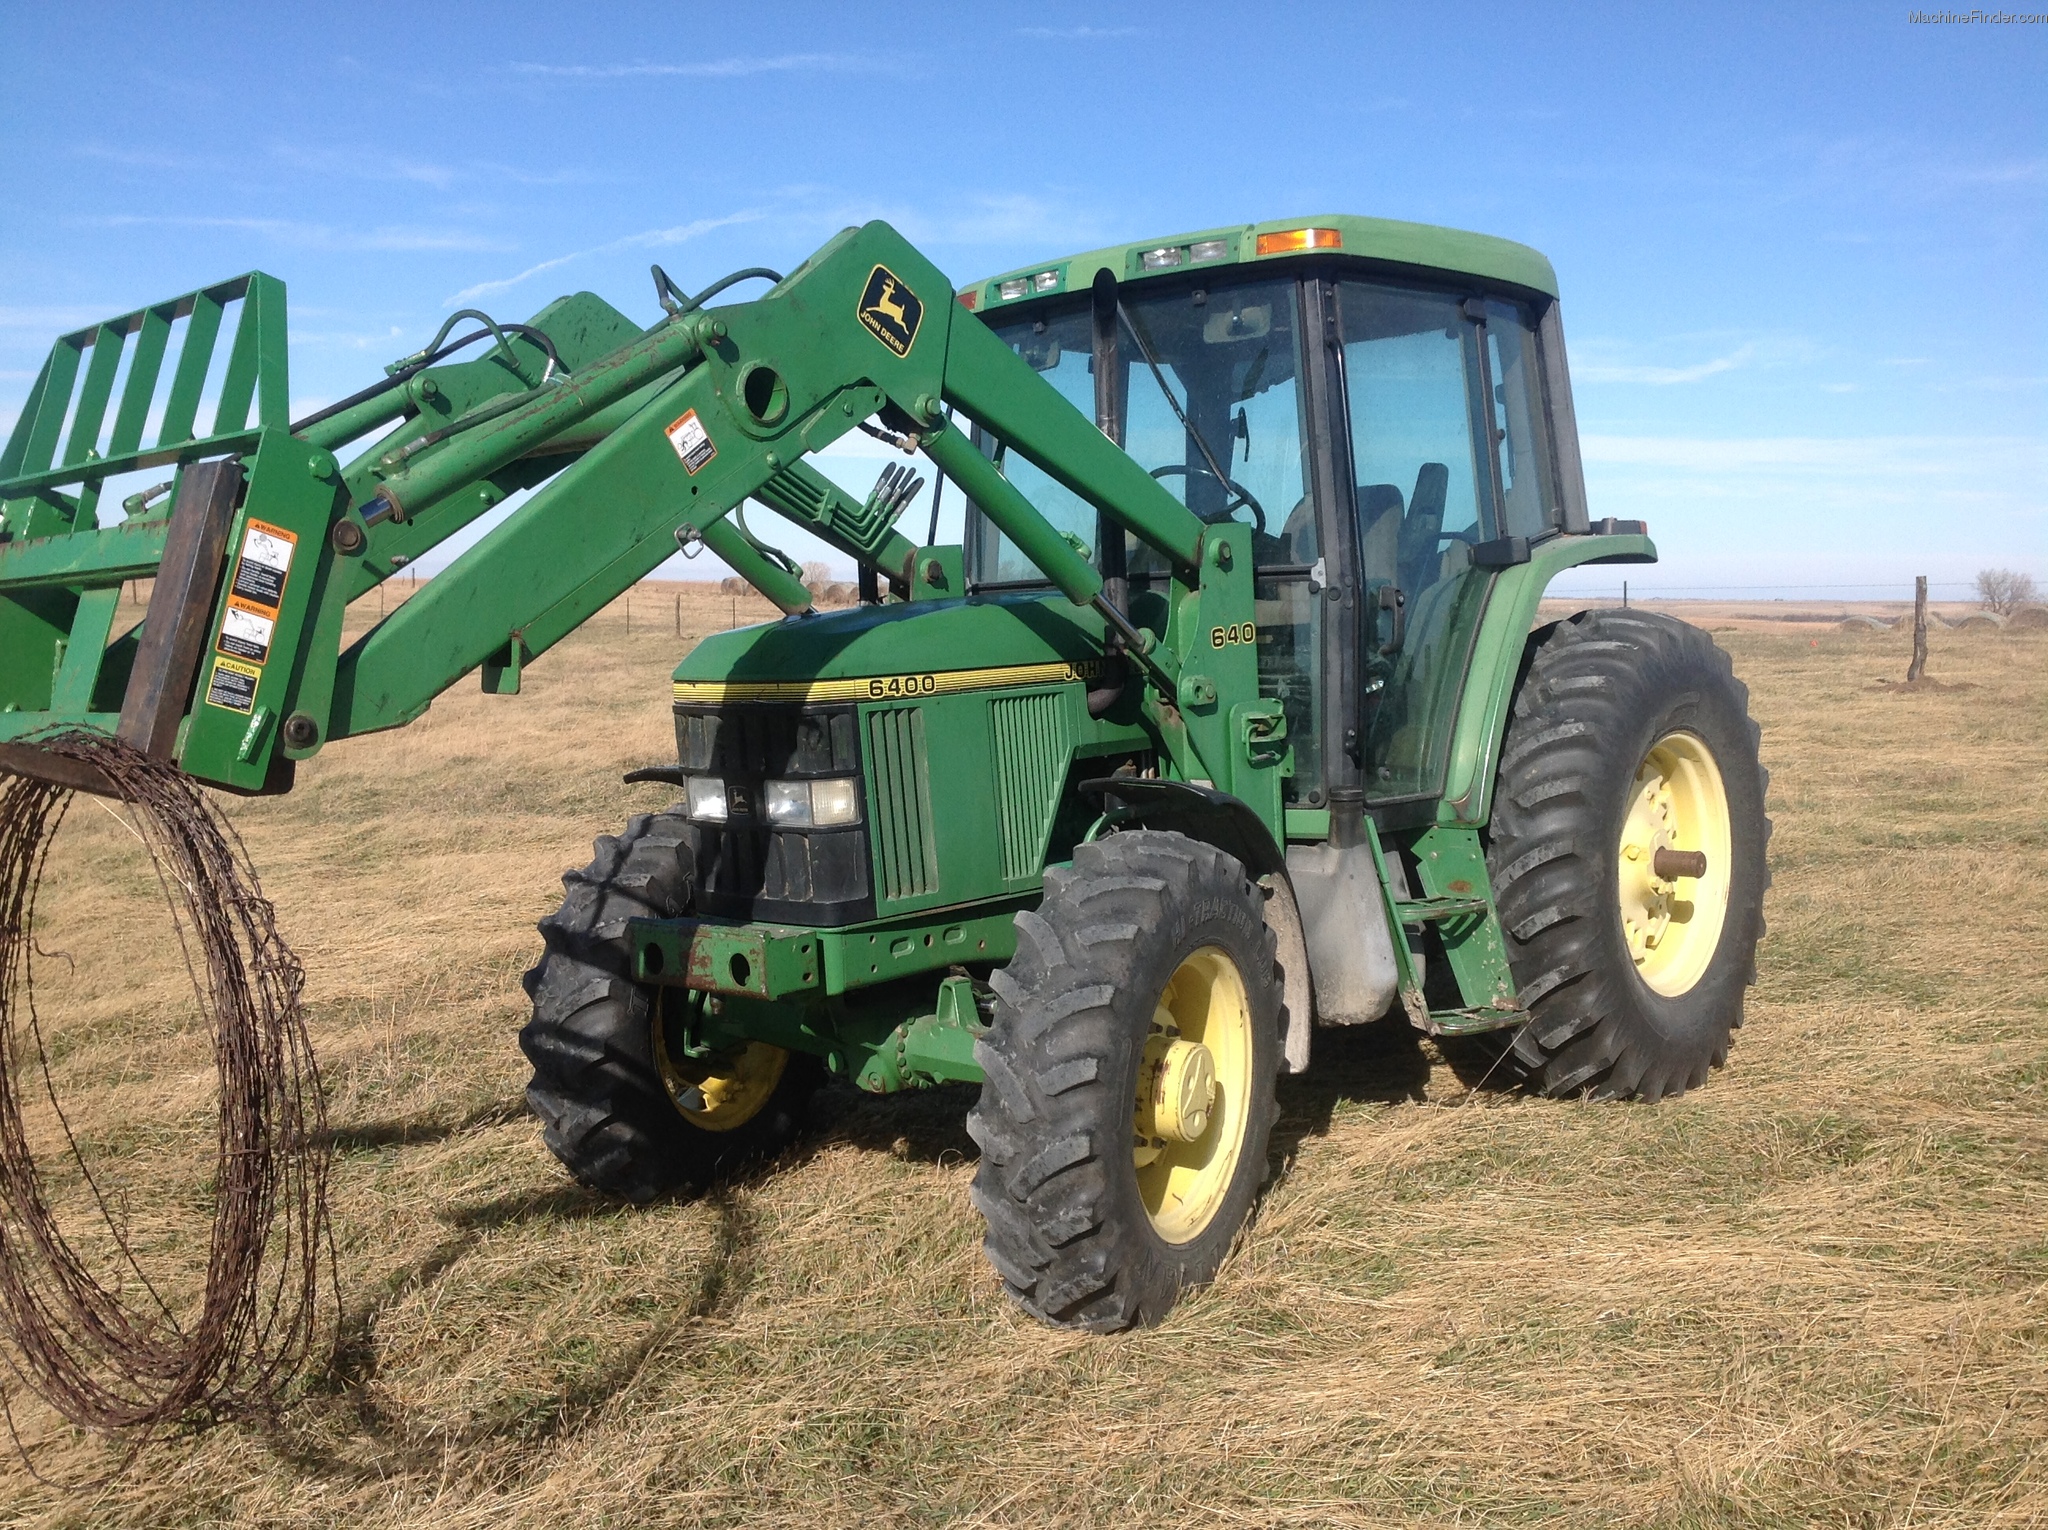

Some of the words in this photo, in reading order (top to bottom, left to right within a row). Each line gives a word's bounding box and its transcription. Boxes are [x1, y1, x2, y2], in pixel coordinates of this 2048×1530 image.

[860, 311, 882, 332] JOHN
[880, 327, 905, 353] DEERE
[260, 525, 291, 540] WARNING
[240, 602, 271, 617] WARNING
[1211, 621, 1256, 649] 640
[226, 662, 256, 676] CAUTION
[868, 675, 936, 699] 6400
